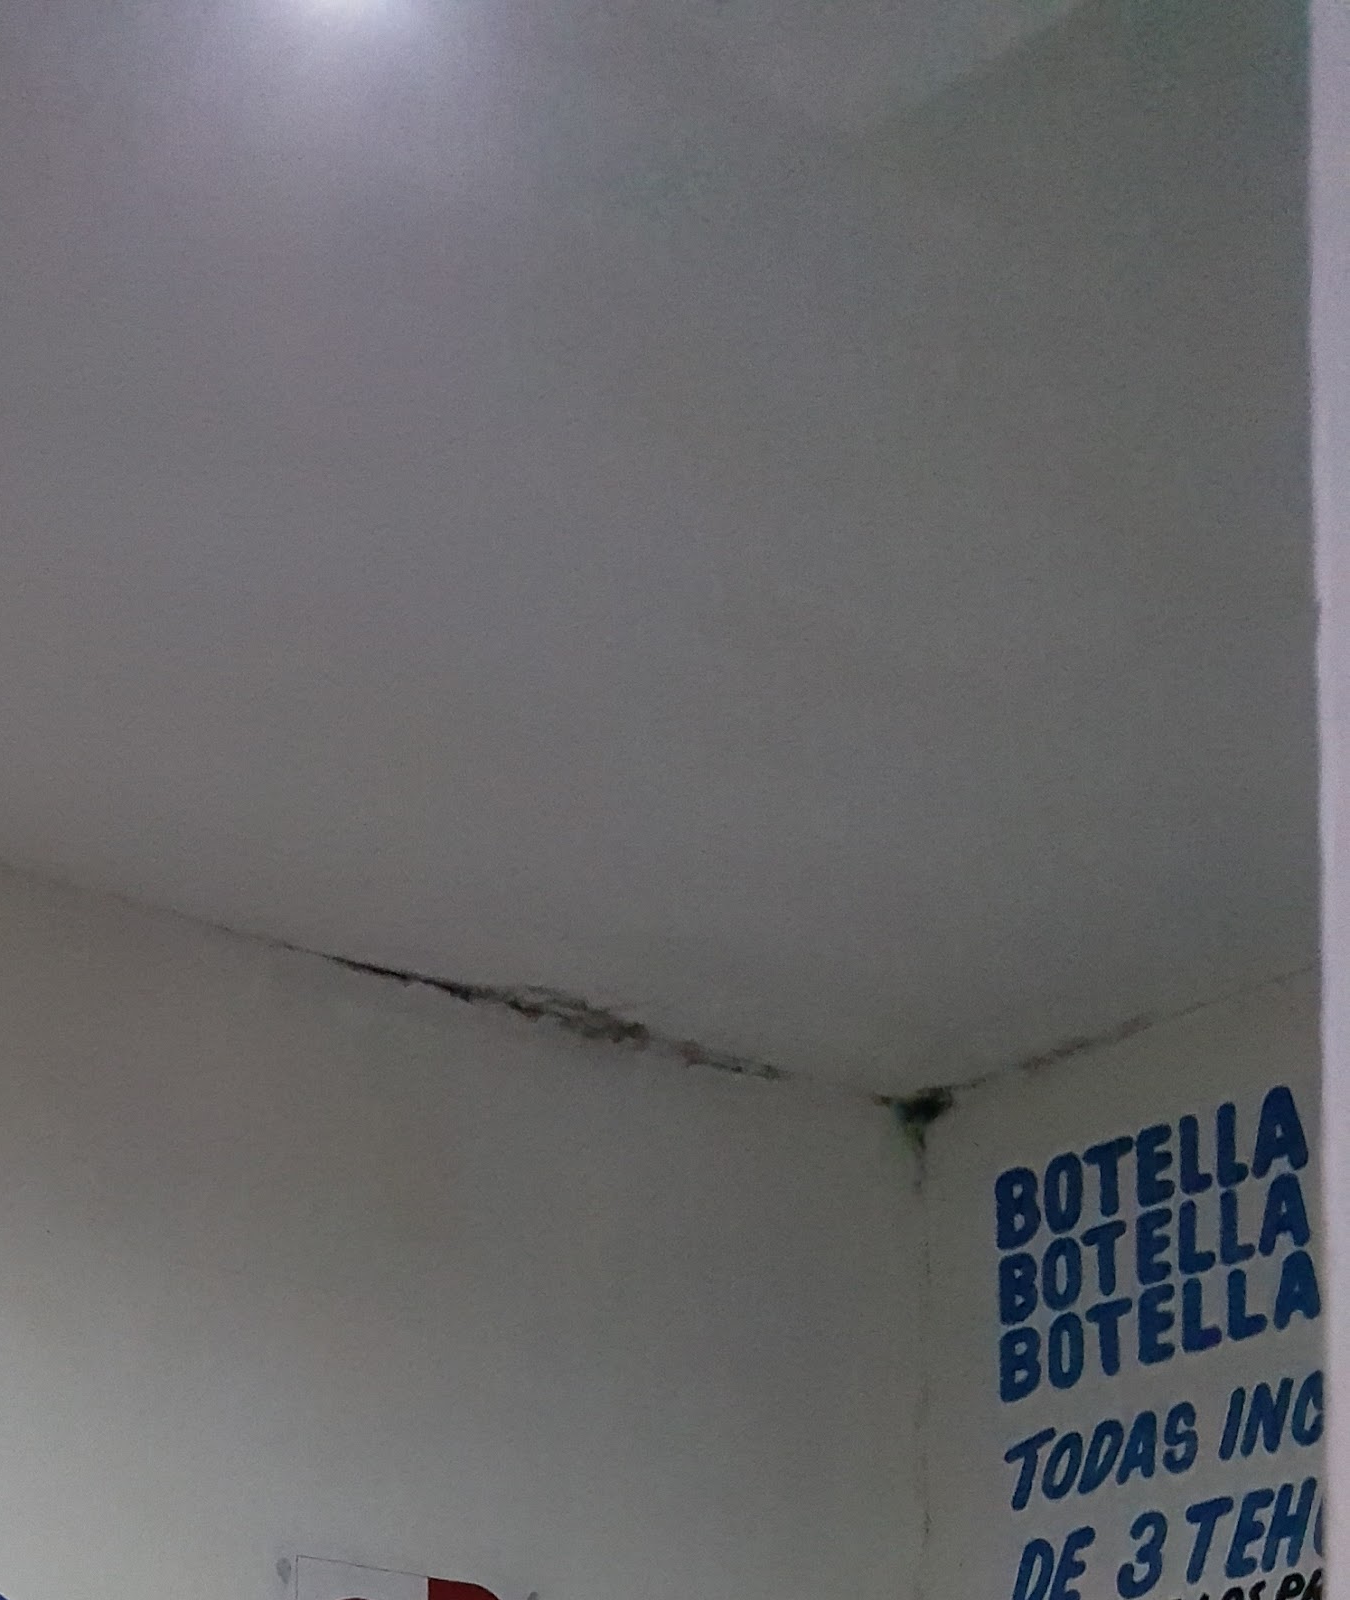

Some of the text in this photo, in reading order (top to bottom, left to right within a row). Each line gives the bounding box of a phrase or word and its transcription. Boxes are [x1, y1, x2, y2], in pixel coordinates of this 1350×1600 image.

[994, 1084, 1309, 1252] BOTELLA
[997, 1173, 1310, 1327] BOTELLA
[998, 1250, 1321, 1403] BOTELLA
[1004, 1401, 1199, 1511] TODAS
[1117, 1511, 1168, 1599] 3
[1185, 1477, 1323, 1585] TEH
